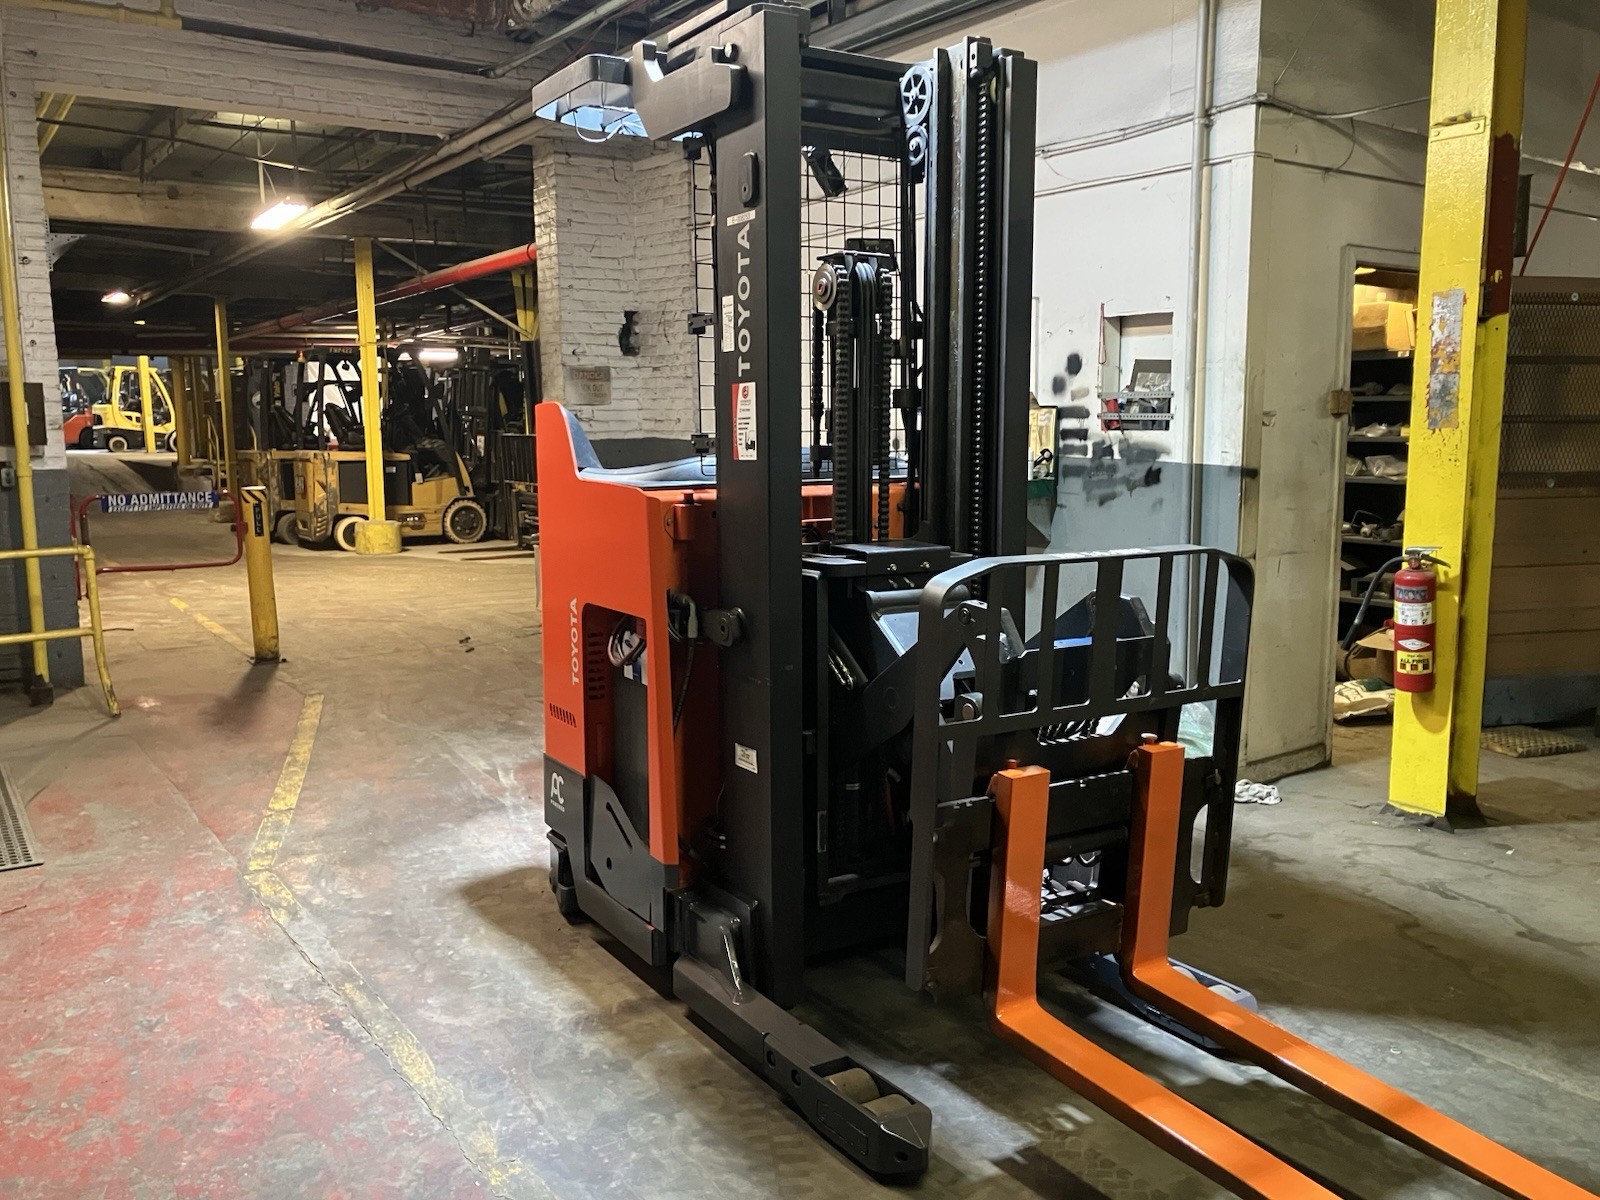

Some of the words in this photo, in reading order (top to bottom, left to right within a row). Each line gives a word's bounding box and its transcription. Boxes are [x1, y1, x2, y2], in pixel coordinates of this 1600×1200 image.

[737, 222, 751, 377] TOYOTA
[108, 494, 126, 506] NO
[130, 491, 212, 505] ADMITTANCE
[569, 598, 580, 685] TOYOTA
